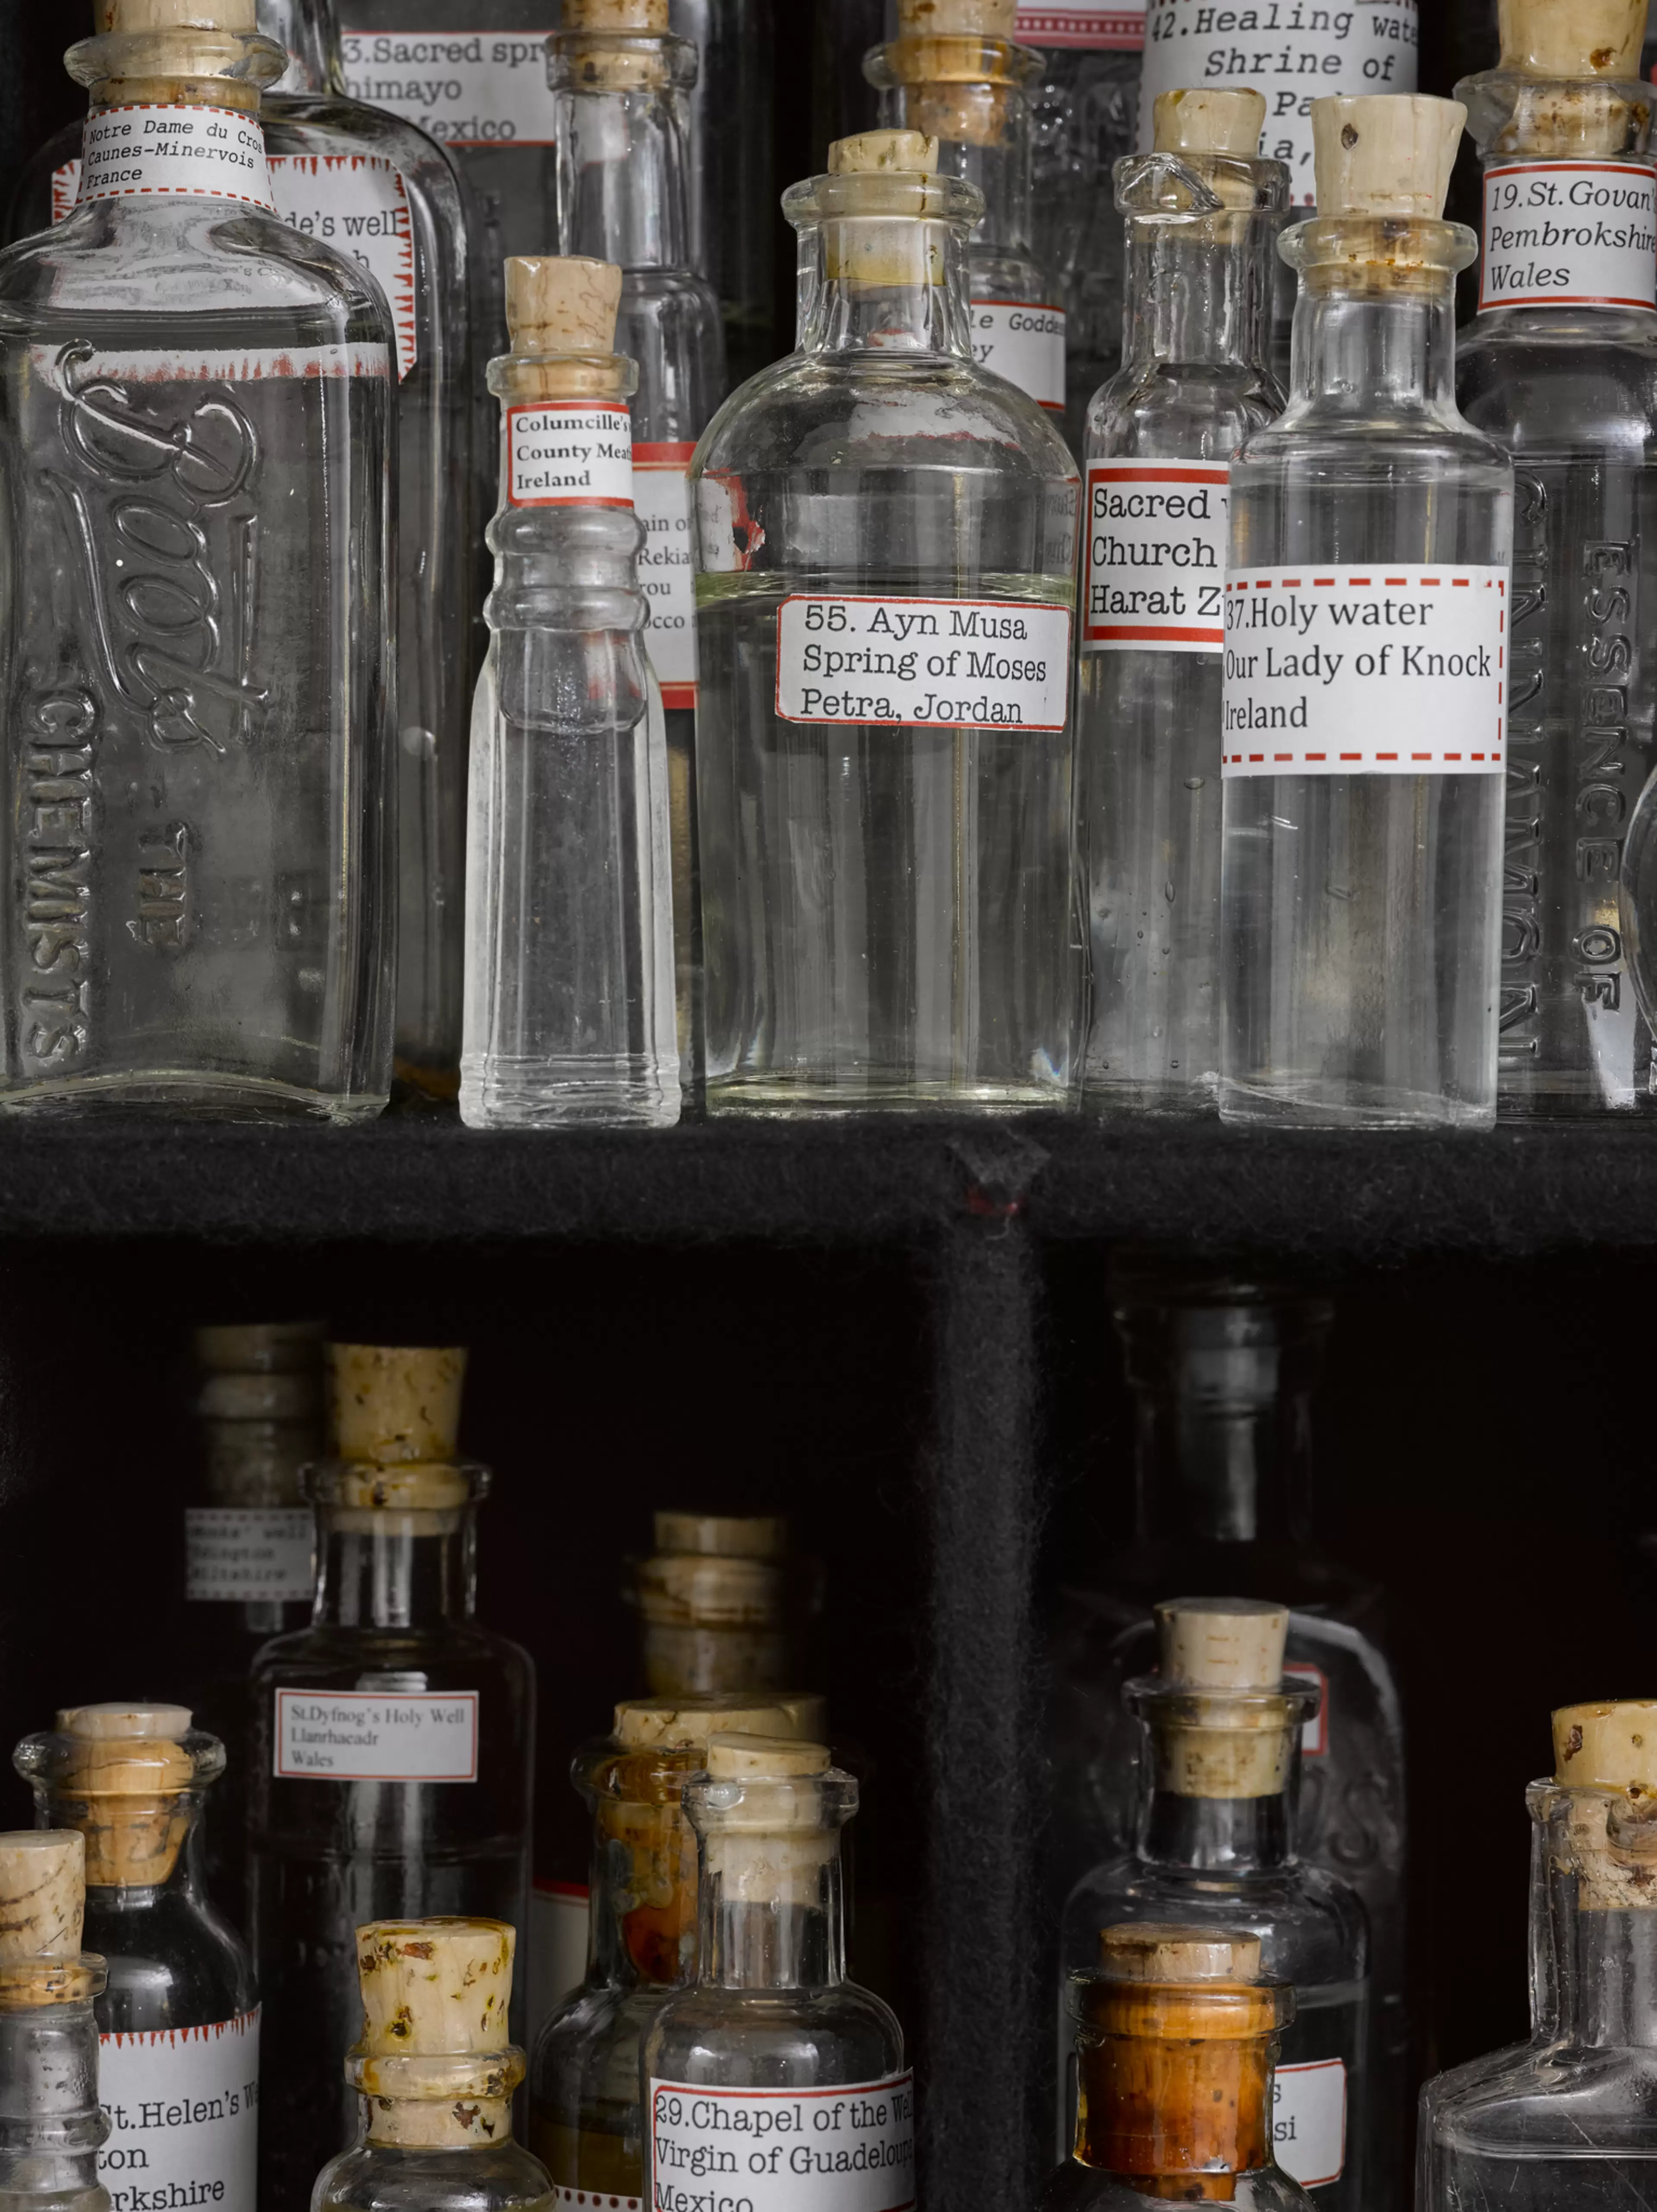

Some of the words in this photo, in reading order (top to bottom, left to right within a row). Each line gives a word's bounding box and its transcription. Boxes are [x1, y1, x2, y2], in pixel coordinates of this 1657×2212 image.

[1204, 45, 1342, 76] Shrine
[1362, 55, 1396, 81] of
[89, 124, 131, 144] Notre
[143, 120, 193, 134] Dame
[207, 123, 227, 139] du
[238, 131, 262, 154] Cros
[88, 142, 254, 169] Caunes-Minervois
[87, 169, 142, 189] France
[342, 211, 397, 237] well
[1490, 221, 1656, 253] Pembrokshire
[1491, 262, 1570, 291] Wales
[516, 414, 627, 432] Columcille's
[517, 445, 592, 463] County
[517, 470, 590, 489] Ireland
[1094, 489, 1211, 519] Sacred
[1092, 536, 1218, 568] Church
[1090, 585, 1186, 615] Harat
[1328, 598, 1433, 626] water
[804, 604, 856, 633] 55.
[866, 607, 939, 641] Ayn
[949, 610, 1028, 640] Musa
[803, 644, 919, 681] Spring
[926, 650, 961, 677] of
[966, 651, 1046, 682] Moses
[1226, 649, 1258, 679] Our
[1266, 644, 1344, 685] Lady
[1355, 644, 1393, 676] of
[1402, 645, 1491, 677] Knock
[800, 688, 903, 723] Petra,
[913, 693, 1023, 723] Jordan
[1225, 696, 1309, 730] Ireland
[1575, 538, 1633, 882] ESSENCE
[1572, 924, 1622, 1011] OF
[385, 1708, 424, 1728] Holy
[430, 1708, 465, 1724] Well
[291, 1750, 334, 1768] Wales
[813, 2102, 845, 2131] of
[850, 2101, 888, 2130] the
[655, 2137, 739, 2177] Virgin
[749, 2146, 783, 2174] of
